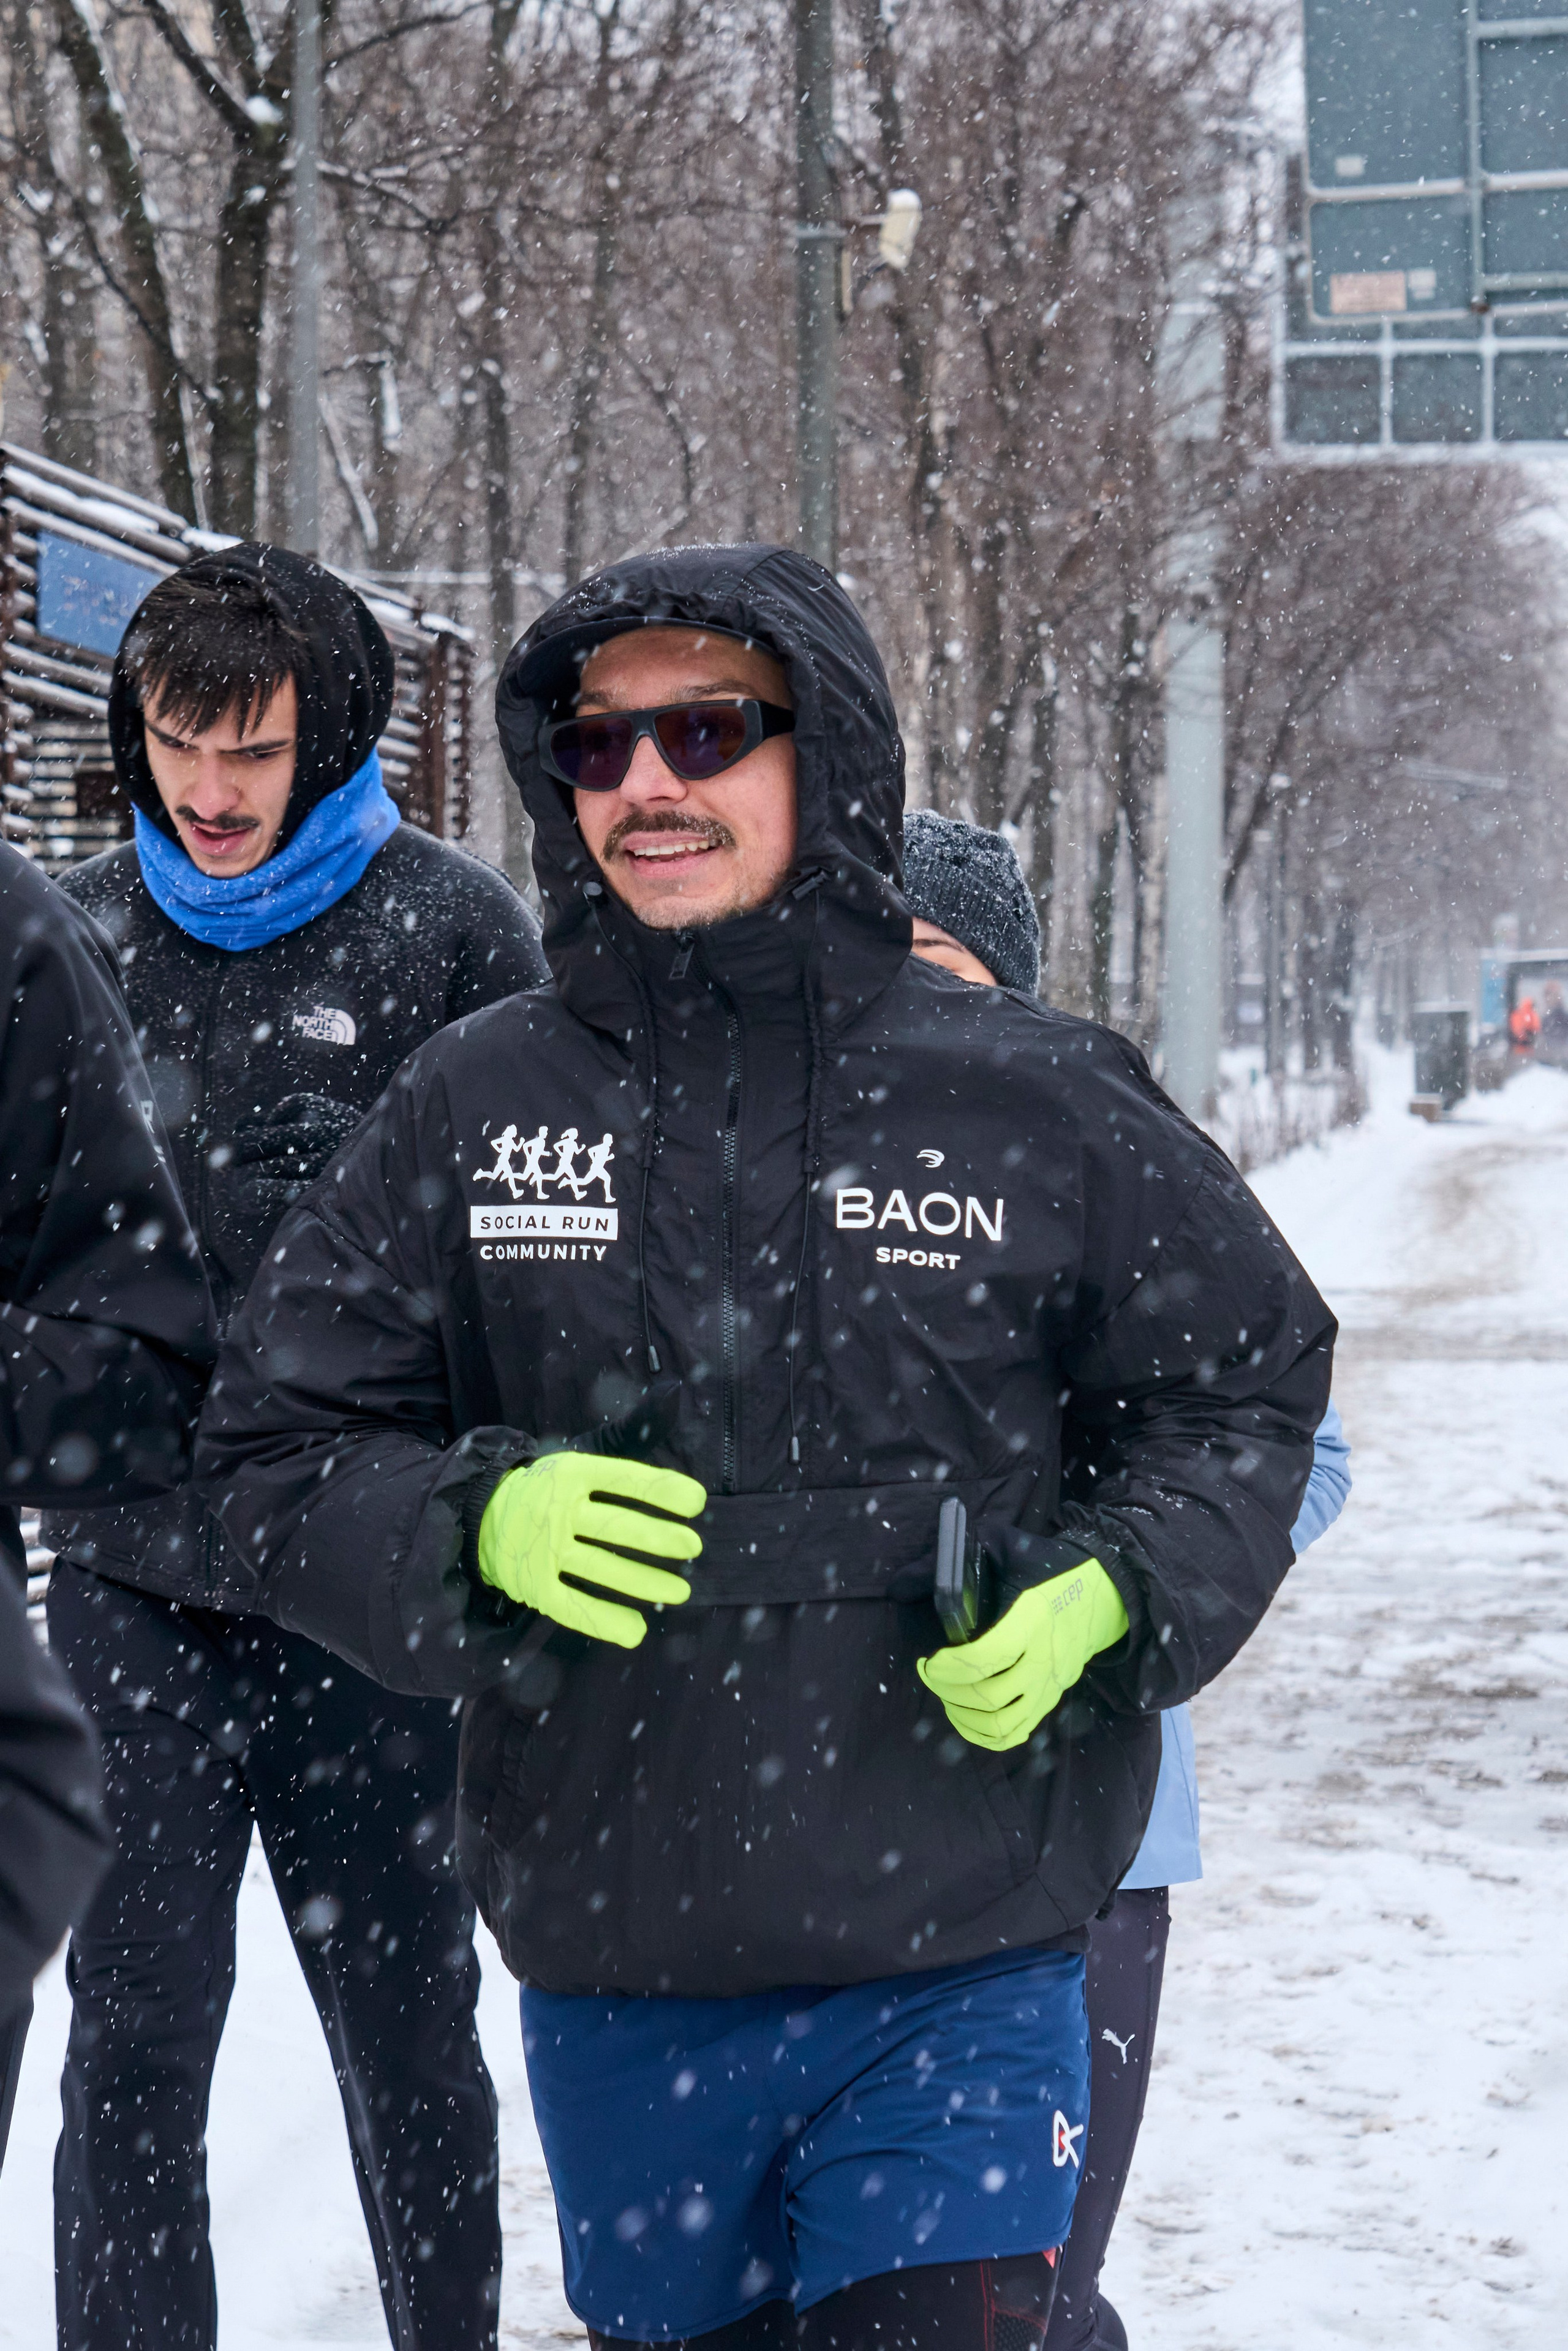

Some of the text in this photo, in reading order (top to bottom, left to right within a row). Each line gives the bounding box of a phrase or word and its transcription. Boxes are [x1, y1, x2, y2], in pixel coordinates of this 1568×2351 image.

[313, 1006, 336, 1019] THE
[292, 1014, 332, 1030] NORTH
[302, 1027, 333, 1041] FACE
[836, 1187, 1004, 1241] BAON
[480, 1215, 609, 1232] SOCIAL RUN
[480, 1243, 607, 1261] COMMUNITY
[876, 1247, 961, 1270] SPORT
[1063, 1578, 1084, 1606] cep
